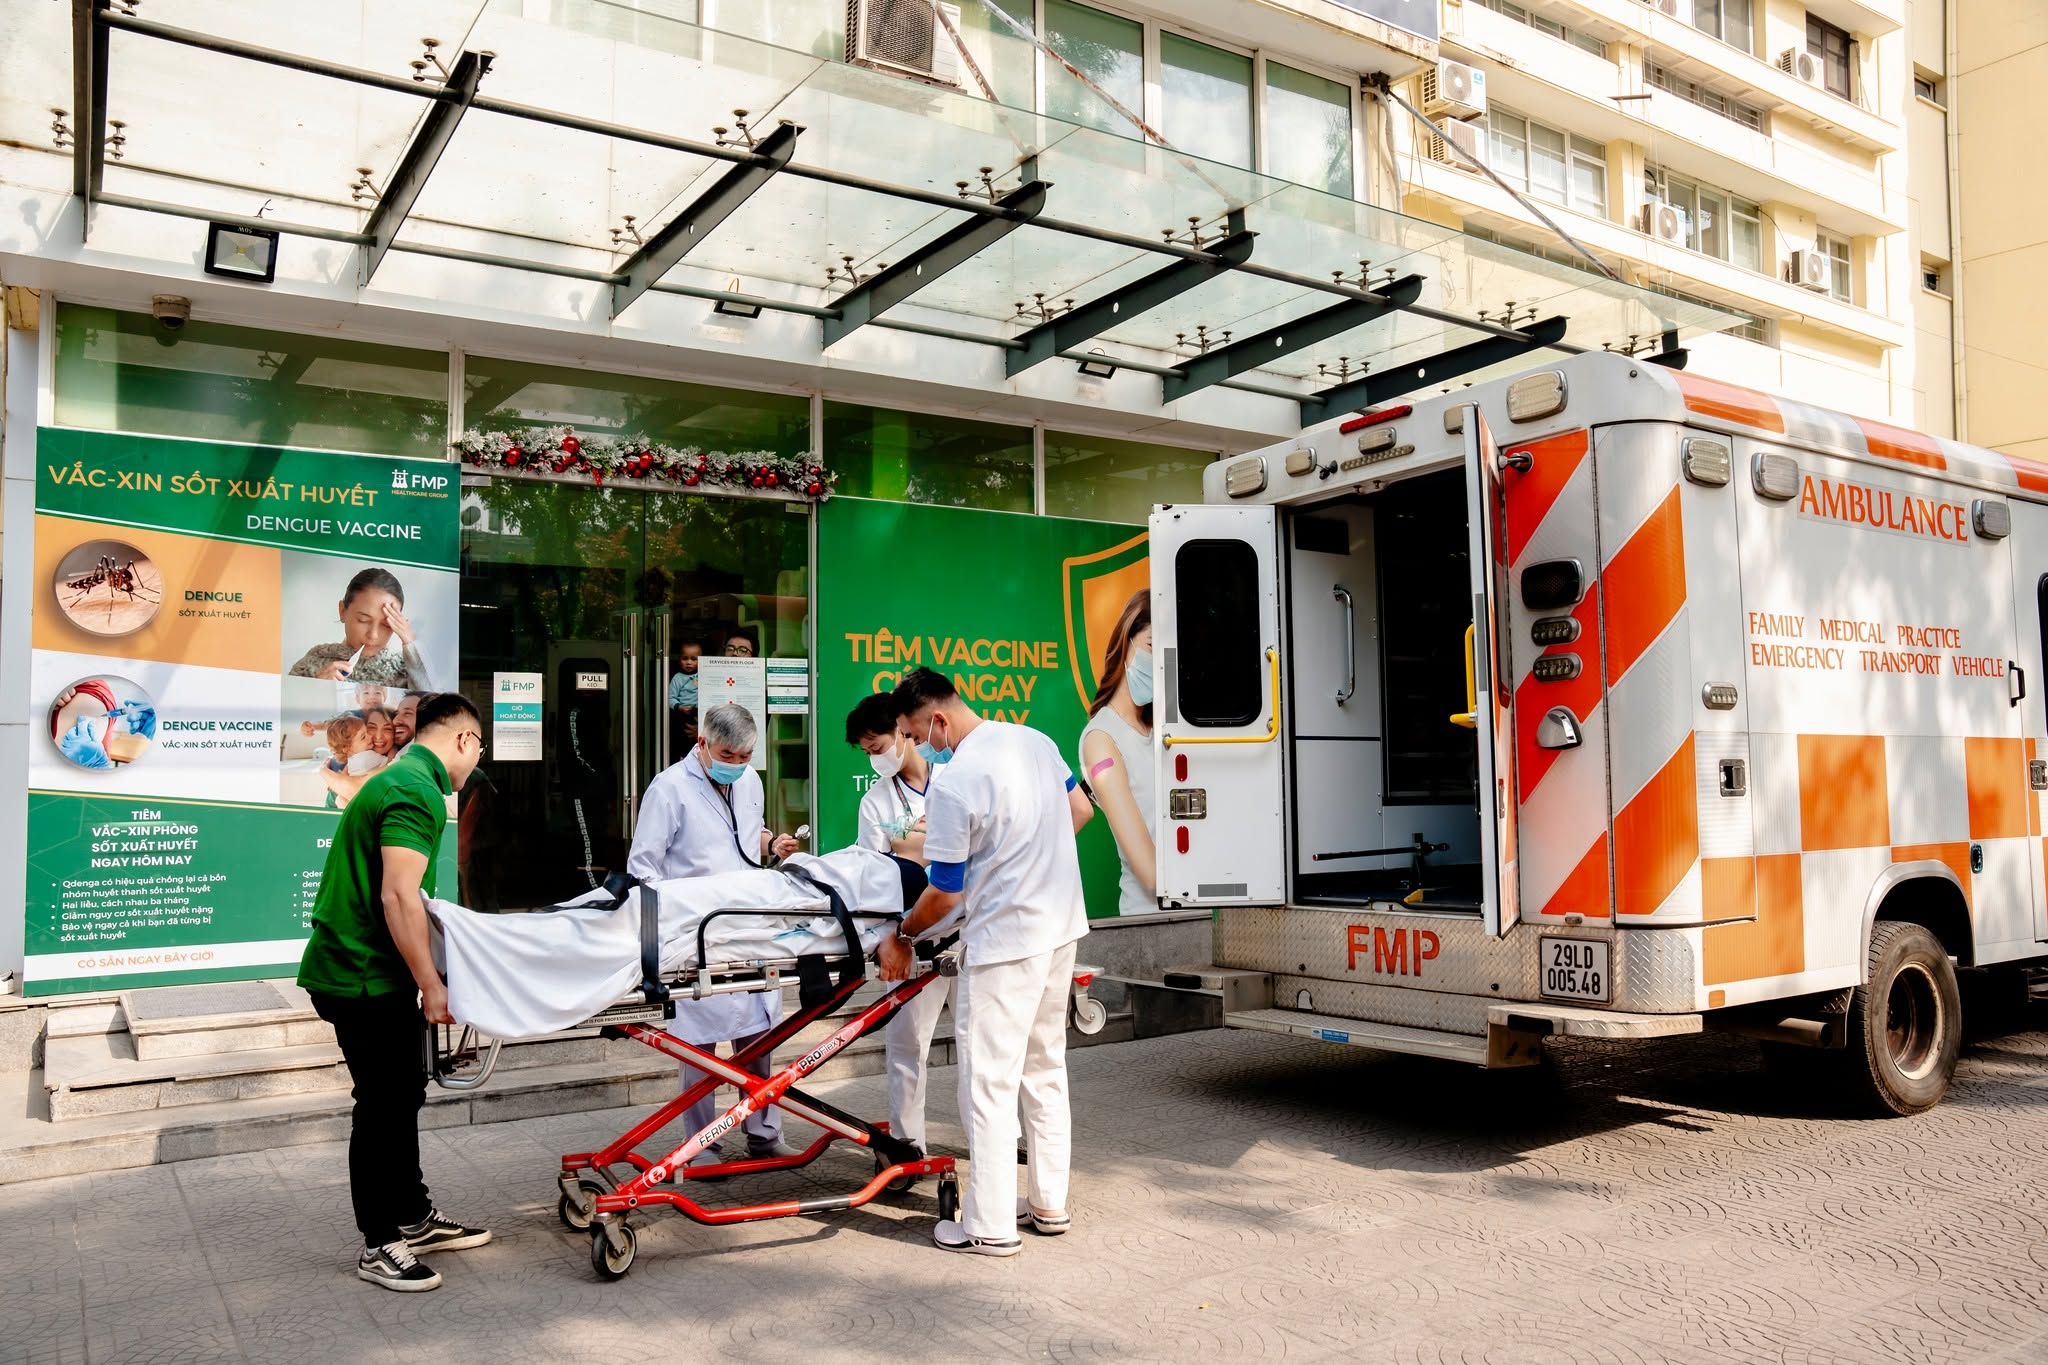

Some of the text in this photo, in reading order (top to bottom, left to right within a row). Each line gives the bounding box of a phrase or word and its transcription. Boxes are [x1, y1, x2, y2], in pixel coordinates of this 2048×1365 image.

[48, 461, 378, 506] VẮC-XIN SỐT XUẤT HUYẾT
[412, 474, 448, 490] FMP
[392, 489, 427, 497] HEALTHCARE
[1800, 475, 1968, 542] AMBULANCE
[247, 515, 421, 540] DENGUE VACCINE
[185, 591, 243, 602] DENGUE
[1748, 612, 1961, 649] FAMILY MEDICAL PRACTICE
[845, 627, 1059, 669] TIÊM VACCINE
[1751, 643, 2005, 678] EMERGENCY TRANSPORT VEHICLE
[513, 683, 535, 691] FMP
[955, 674, 1038, 703] NGAY
[163, 721, 273, 731] DENGUE VACCINE
[132, 808, 161, 820] TIÊM
[92, 823, 198, 837] VẮC-XIN PHÒNG
[91, 837, 198, 852] SỐT XUẤT HUYẾT
[91, 855, 192, 868] NGAY HÔM NAY
[63, 880, 100, 888] Qdenga
[115, 878, 135, 886] hiệu
[137, 877, 154, 885] quả
[156, 875, 183, 884] chống
[186, 875, 196, 884] lại
[93, 888, 119, 897] huyết
[121, 888, 147, 896] thanh
[150, 886, 163, 894] sốt
[165, 885, 185, 893] xuất
[187, 884, 211, 893] huyết
[101, 899, 123, 907] cách
[164, 897, 189, 905] tháng
[62, 912, 87, 920] Giảm
[127, 908, 141, 917] sốt
[165, 906, 189, 915] huyết
[192, 906, 214, 914] nặng
[62, 923, 80, 931] Bảo
[82, 922, 93, 931] vệ
[95, 922, 117, 930] ngay
[132, 919, 146, 927] khi
[148, 919, 165, 927] bạn
[203, 916, 211, 924] bị
[60, 930, 126, 941] sốt xuất huyết
[1348, 925, 1440, 977] FMP
[1554, 943, 1593, 969] 29LD
[127, 955, 161, 965] NGAY
[164, 952, 188, 963] BÂY
[1548, 968, 1600, 995] 005.48
[605, 1014, 639, 1022] PROFESSIONAL
[698, 1116, 734, 1147] FERNO
